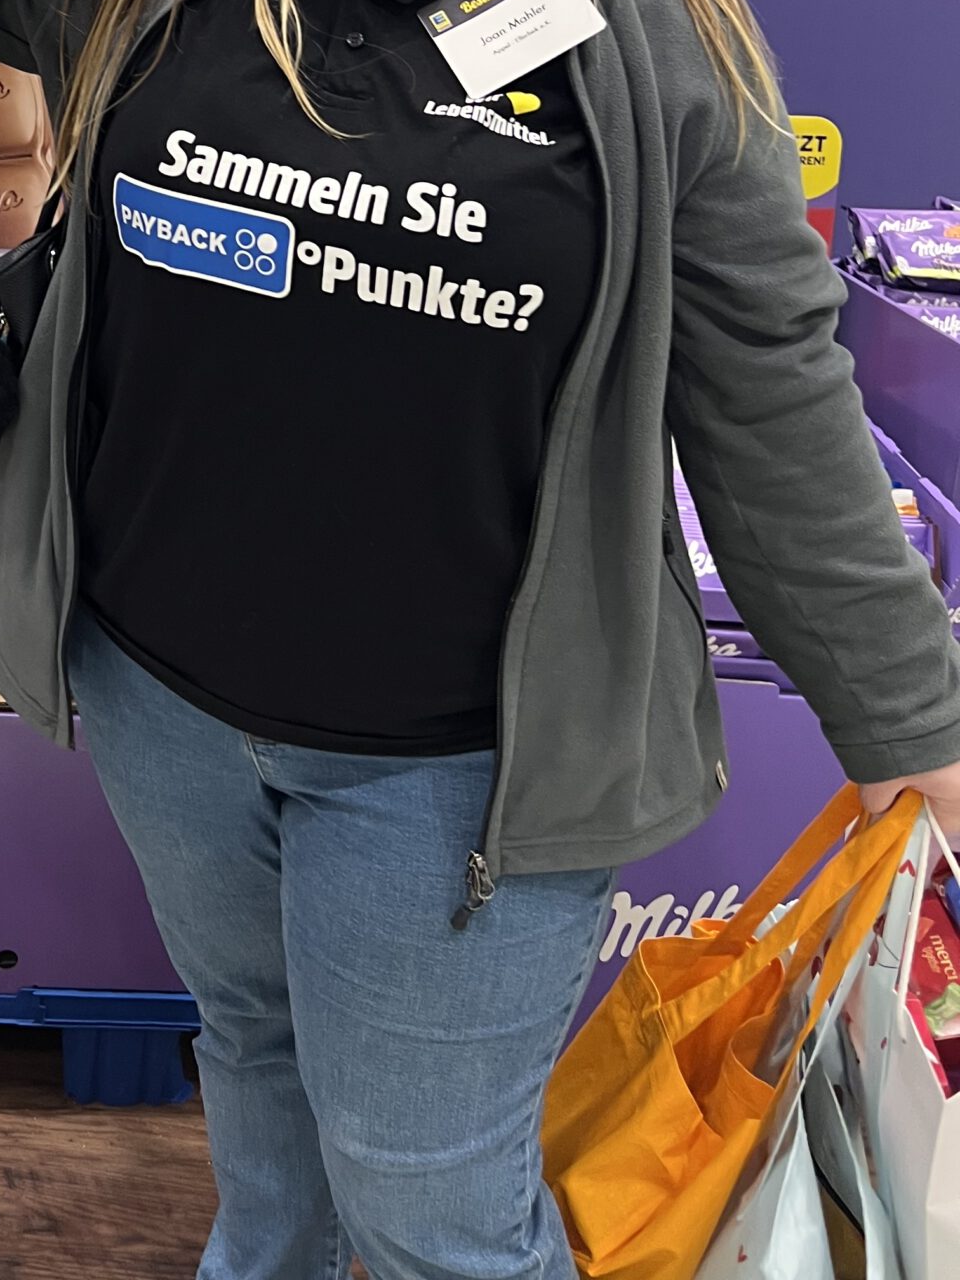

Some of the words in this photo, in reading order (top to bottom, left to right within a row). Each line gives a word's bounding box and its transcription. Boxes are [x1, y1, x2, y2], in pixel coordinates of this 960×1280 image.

[481, 26, 507, 47] Joan
[509, 3, 548, 31] Mahler
[158, 129, 390, 226] Sammeln
[121, 204, 227, 256] PAYBACK
[401, 181, 488, 244] Sie
[878, 217, 934, 234] Milka
[930, 934, 958, 981] merci
